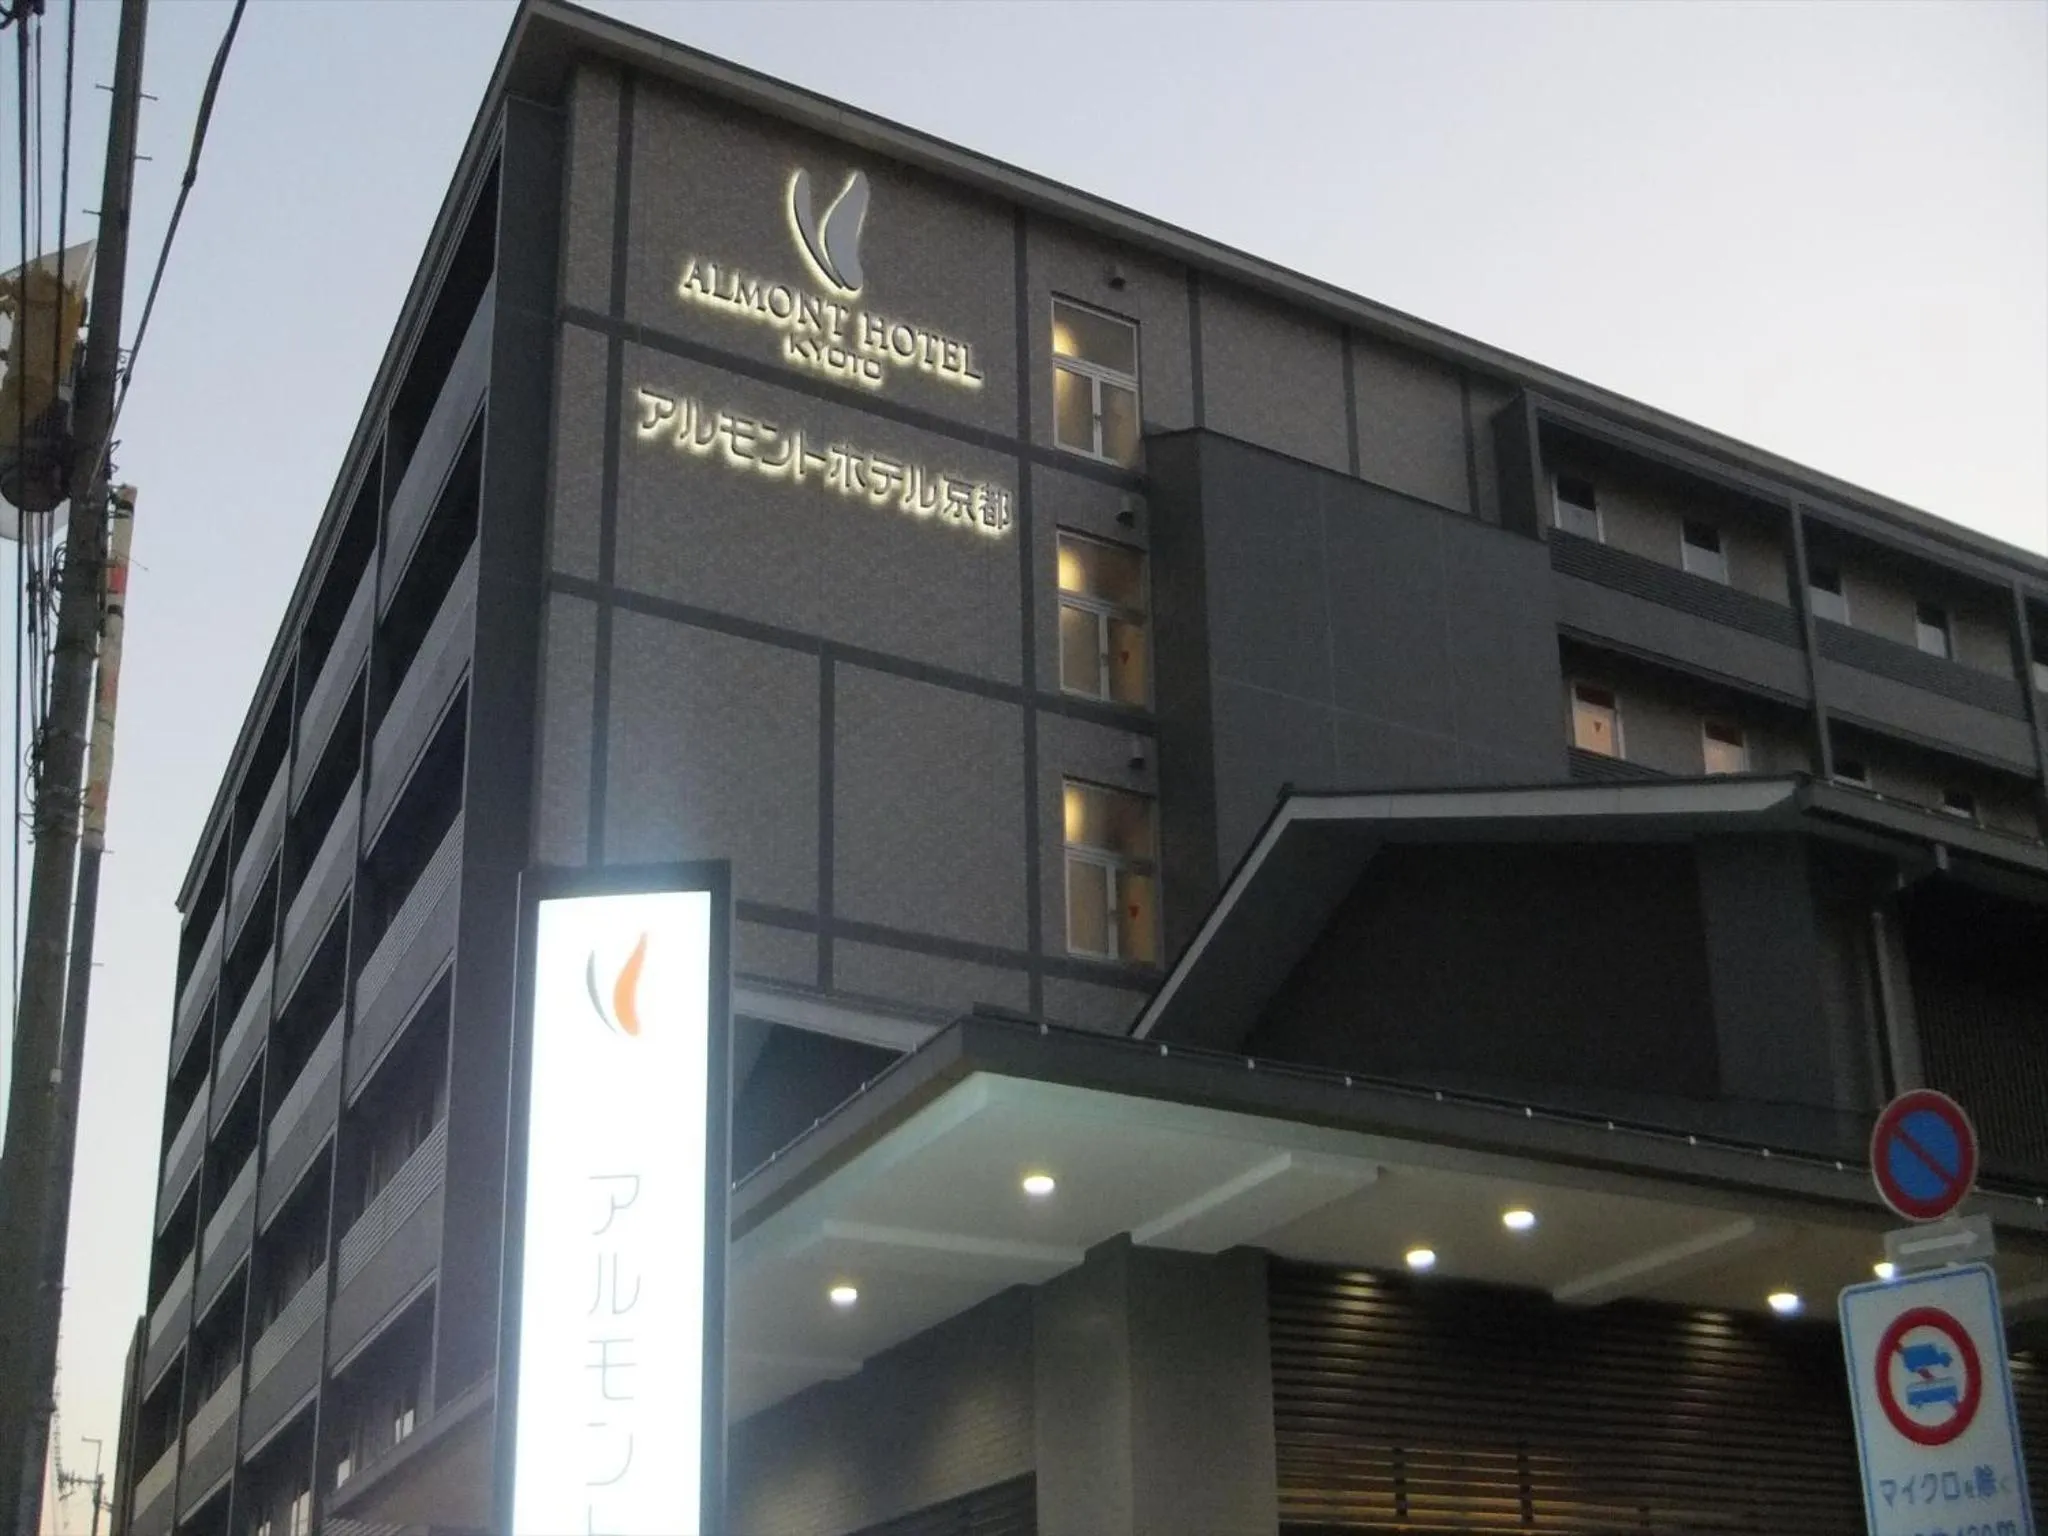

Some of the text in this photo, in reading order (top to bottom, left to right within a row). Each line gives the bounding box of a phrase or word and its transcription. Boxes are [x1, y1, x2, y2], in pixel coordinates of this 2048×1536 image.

[680, 261, 983, 383] ALMONT HOTEL
[787, 332, 884, 384] KYOTO
[638, 388, 1012, 533] アルモントホテル京都
